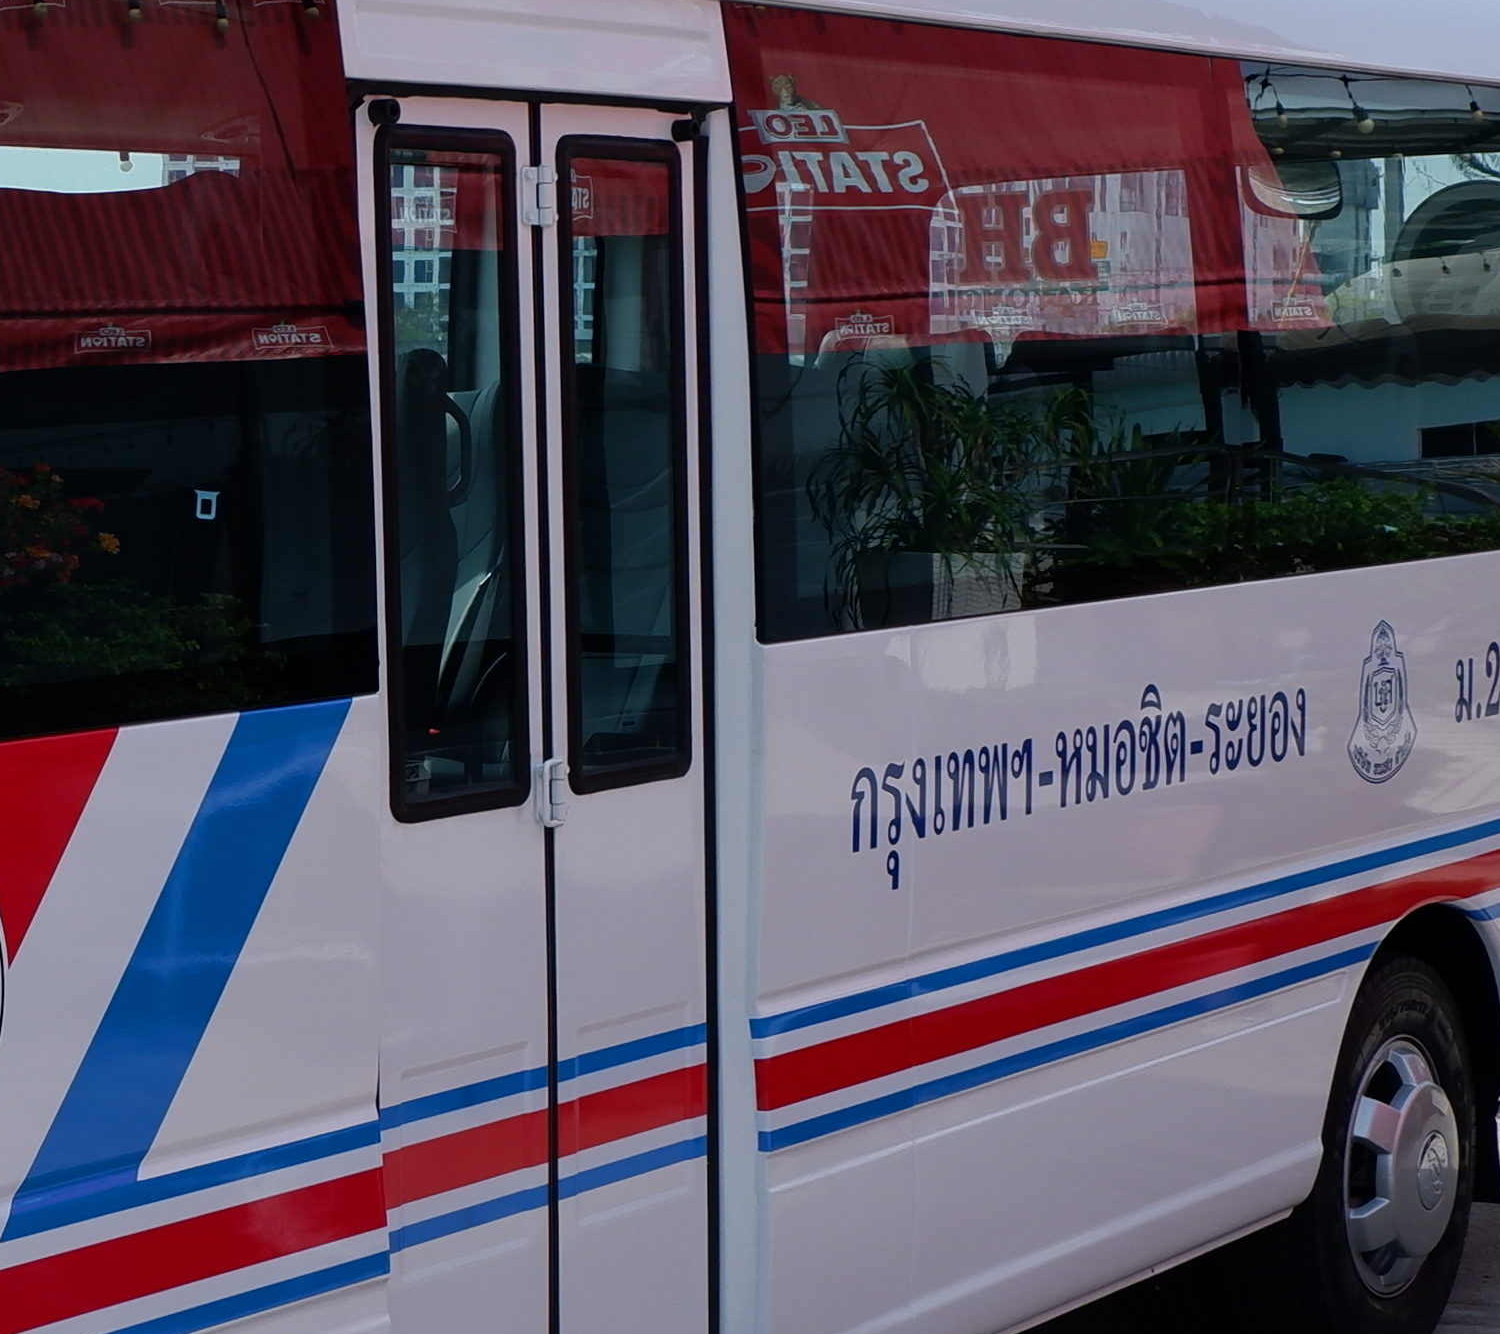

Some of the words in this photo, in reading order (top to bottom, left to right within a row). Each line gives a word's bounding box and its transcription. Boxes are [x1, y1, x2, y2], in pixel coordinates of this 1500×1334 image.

[851, 683, 1308, 890] กรุงเทพฯ-หมอชิต-ระยอง
